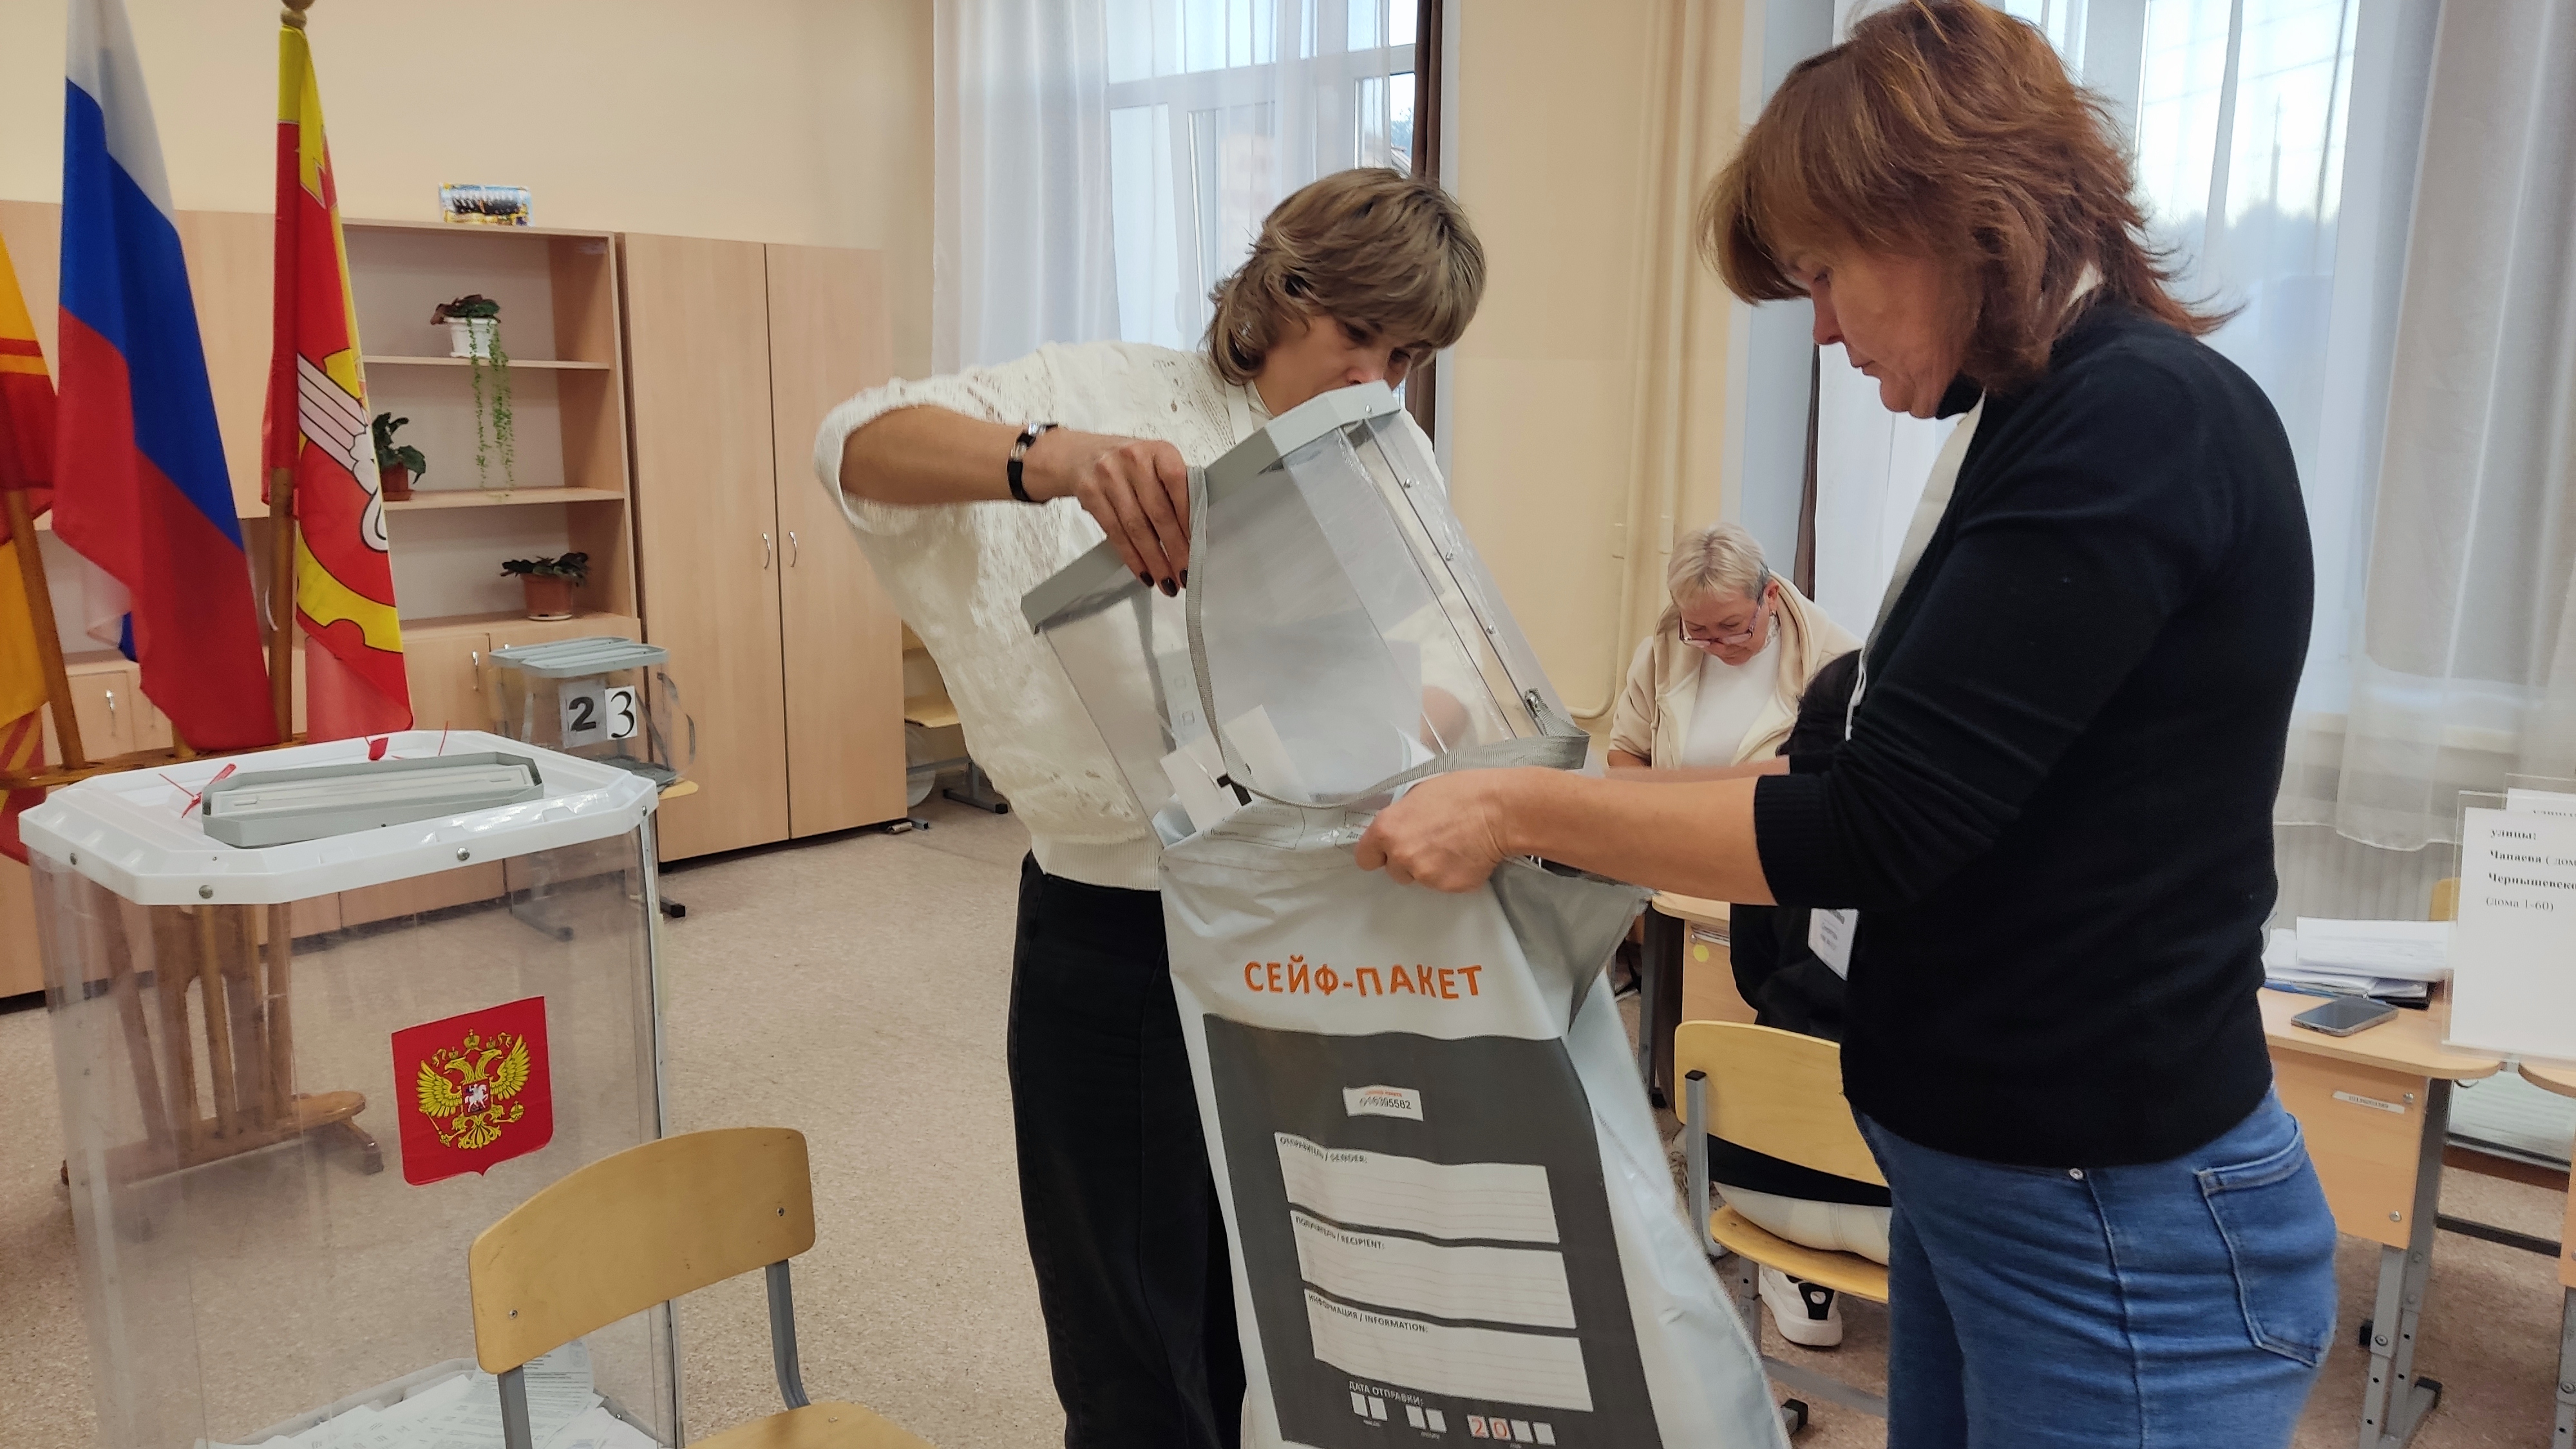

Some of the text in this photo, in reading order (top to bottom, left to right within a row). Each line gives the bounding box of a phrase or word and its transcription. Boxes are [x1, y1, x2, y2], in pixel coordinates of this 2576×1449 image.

[2490, 849, 2541, 864] Чапаева
[2486, 897, 2554, 913] (дома 1-60)
[1244, 953, 1482, 999] СЕЙФ-ПАКЕТ
[1341, 1235, 1385, 1249] RECIPIENT:
[1309, 1293, 1358, 1320] ИНФОРМАЦИЯ
[1365, 1314, 1429, 1334] INFORMATION:
[1349, 1380, 1425, 1407] ДАТА ОТПРАВКИ:
